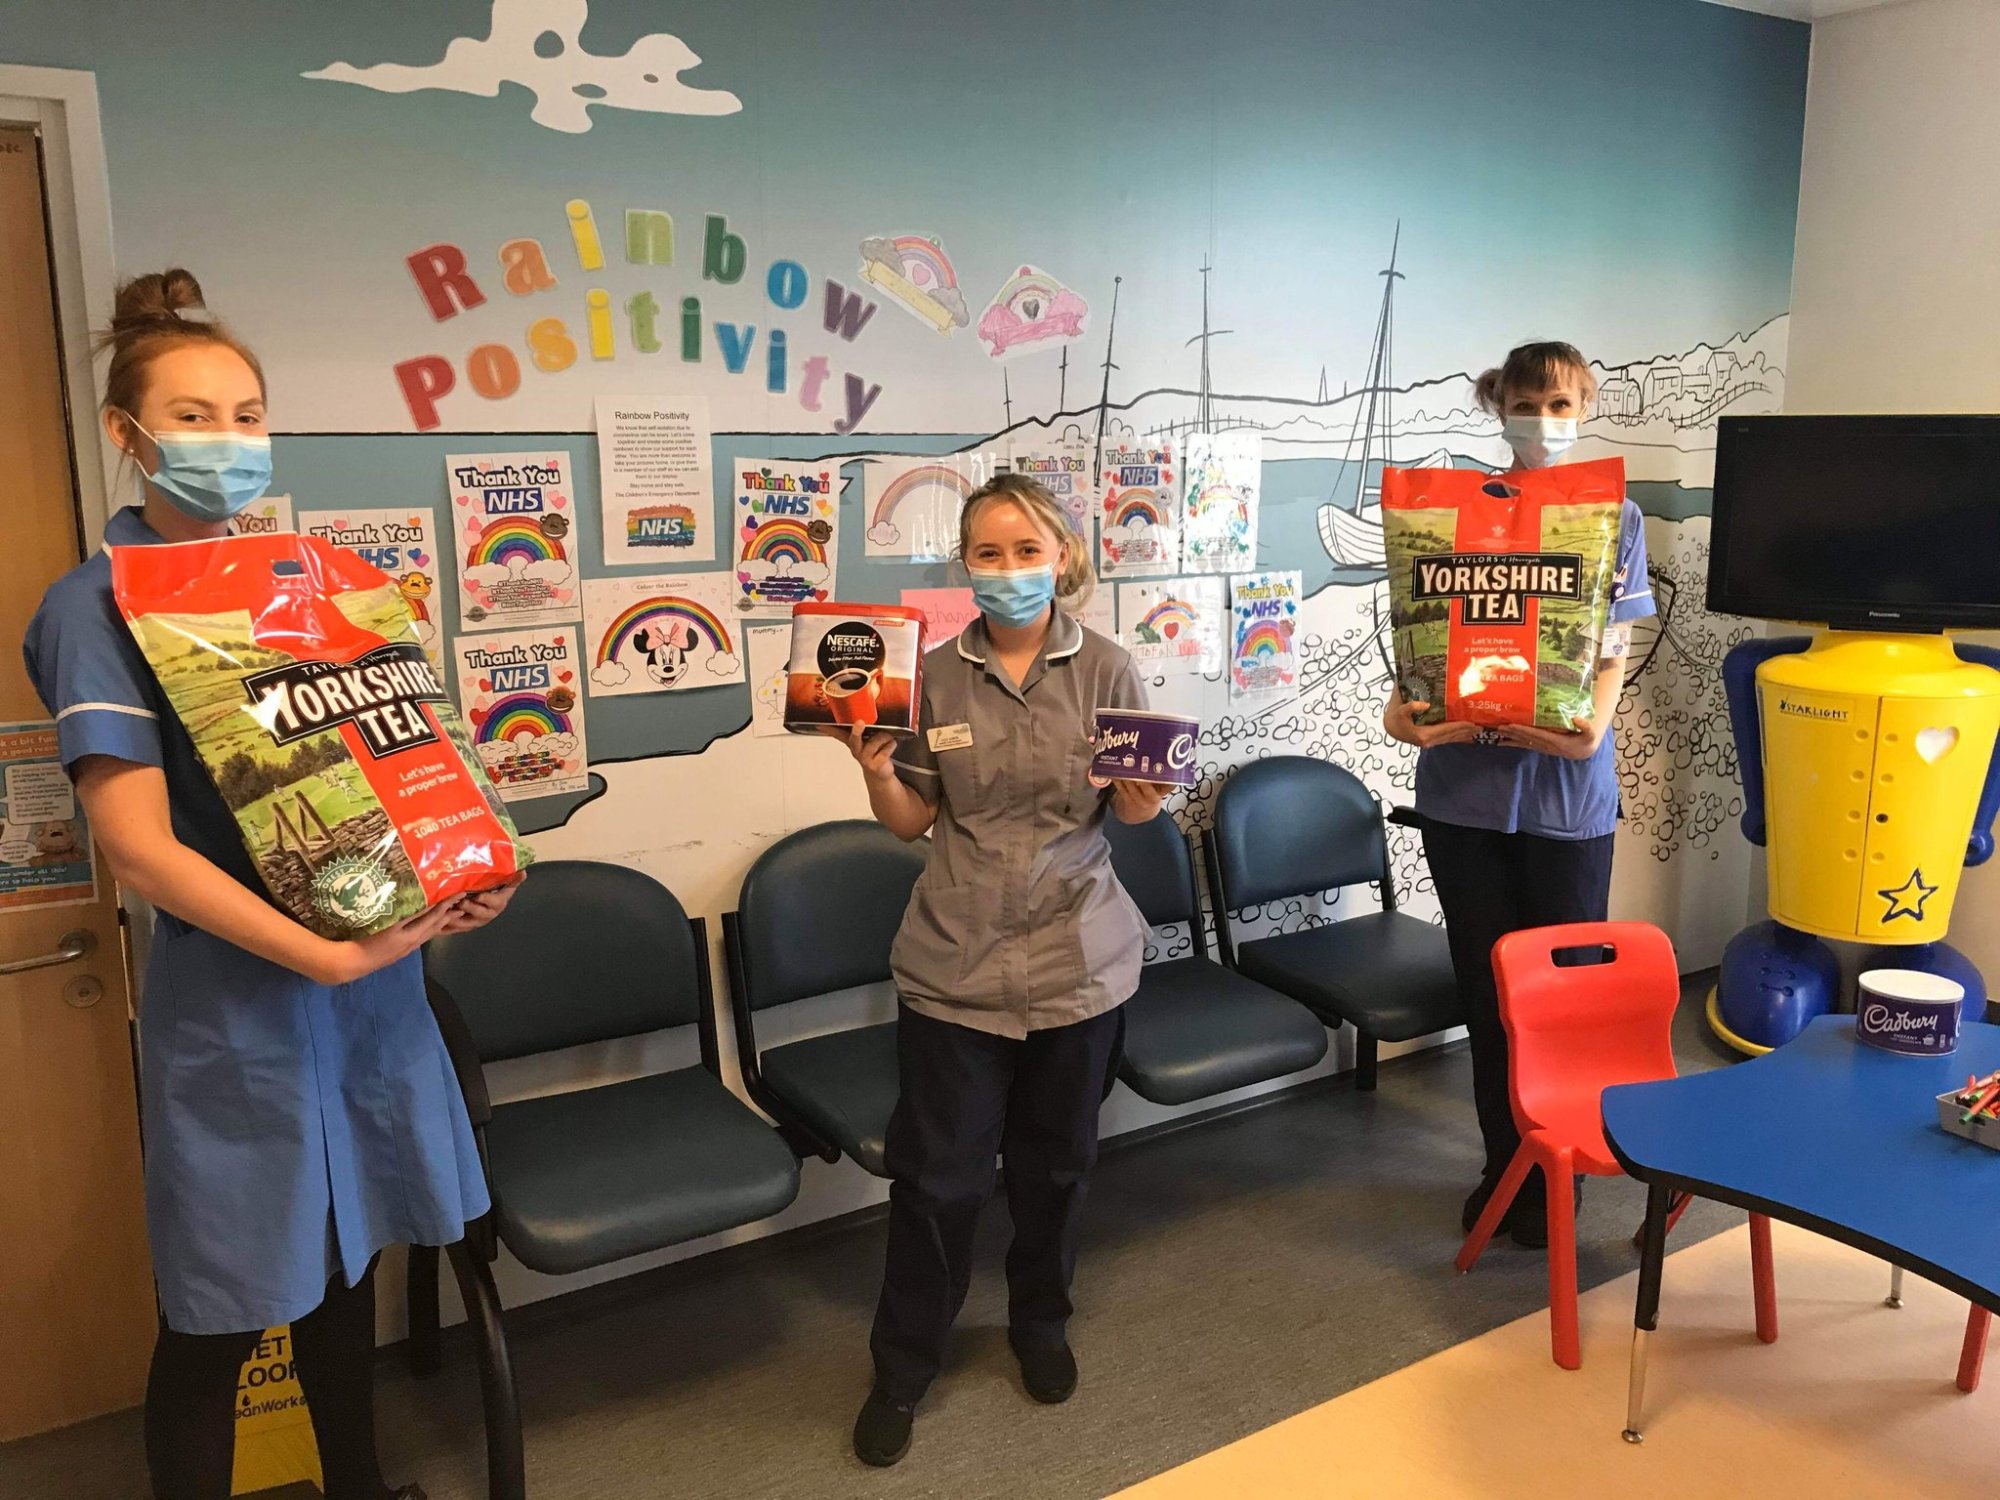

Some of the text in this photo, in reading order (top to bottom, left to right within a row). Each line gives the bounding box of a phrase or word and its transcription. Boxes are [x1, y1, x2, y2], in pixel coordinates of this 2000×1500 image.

[404, 198, 877, 343] Rainbow
[393, 288, 883, 435] Positivity
[615, 411, 690, 421] Rainbow Positivity
[1015, 456, 1085, 472] Thank You
[1106, 449, 1171, 465] Thank You
[455, 464, 561, 488] Thank You
[743, 471, 830, 494] Thank You
[1122, 467, 1157, 486] NHS
[488, 490, 539, 512] NHS
[764, 494, 811, 515] NHS
[234, 513, 277, 533] You
[641, 518, 682, 536] NHS
[310, 524, 424, 546] Thank You
[1452, 556, 1498, 564] TAYLORS
[1420, 563, 1574, 594] YORKSHIRE
[1236, 583, 1294, 600] Thank You
[1252, 600, 1281, 618] NHS
[1469, 594, 1519, 619] TEA
[831, 645, 873, 653] ORIGINAL
[1470, 646, 1497, 654] proper
[1471, 637, 1514, 645] Let's have
[465, 643, 567, 669] Thank You
[495, 666, 546, 691] NHS
[1499, 674, 1525, 683] BAGS
[261, 660, 444, 731] YORKSHIRE
[1468, 701, 1502, 711] 3.25kg
[1787, 703, 1848, 719] STARLIGHT
[358, 701, 431, 747] TEA
[399, 762, 446, 782] Let's have
[398, 772, 459, 798] a proper brew
[439, 814, 461, 829] TEA
[459, 805, 485, 821] BAGS
[1864, 1003, 1938, 1034] Cadbury
[252, 1335, 287, 1361] ET
